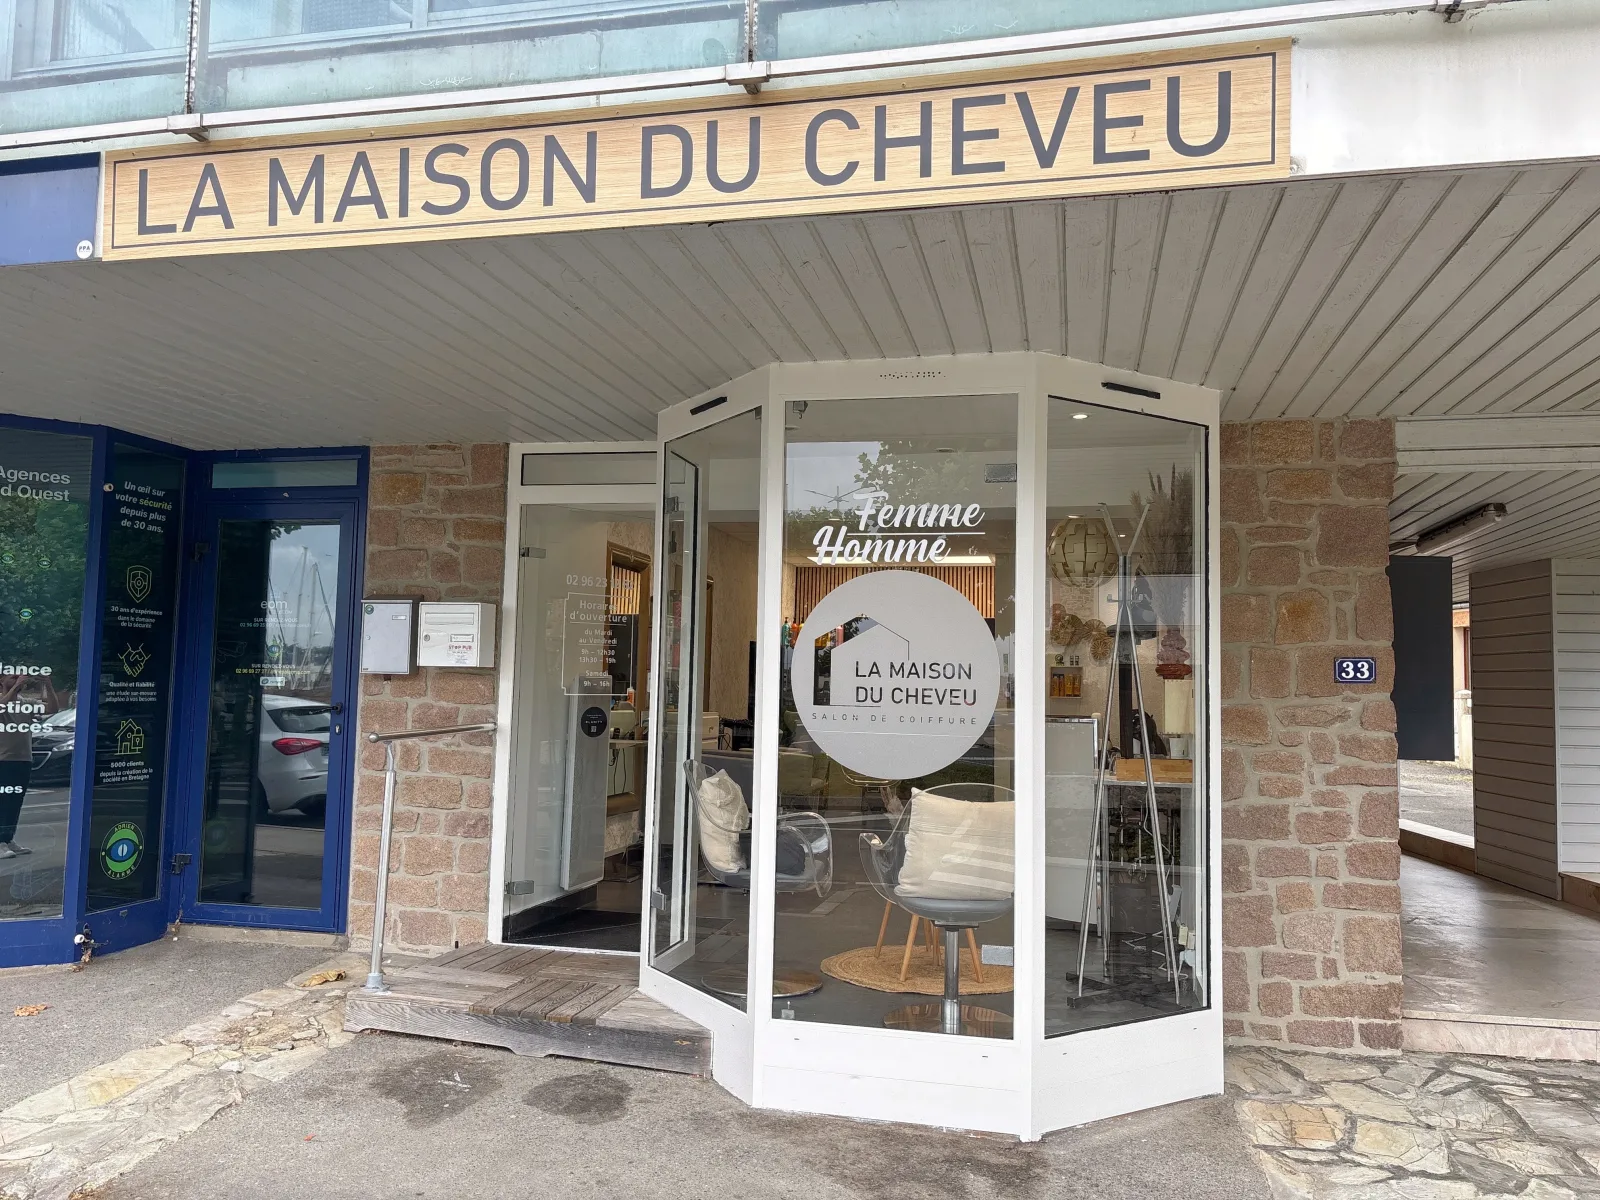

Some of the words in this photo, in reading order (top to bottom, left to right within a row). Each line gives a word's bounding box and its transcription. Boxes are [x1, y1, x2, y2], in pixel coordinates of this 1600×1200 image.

[138, 163, 235, 236] LA
[268, 131, 597, 226] MAISON
[640, 116, 761, 199] DU
[805, 70, 1231, 187] CHEVEU
[0, 466, 70, 485] Agences
[18, 485, 70, 501] Ouest
[124, 482, 136, 490] Un
[138, 484, 151, 494] œil
[152, 488, 166, 497] sur
[116, 493, 138, 504] votre
[140, 497, 172, 510] sécurité
[120, 506, 148, 518] depuis
[148, 512, 166, 523] plus
[852, 490, 985, 531] Femme
[121, 518, 132, 528] de
[134, 520, 146, 530] 30
[147, 524, 164, 532] ans.
[812, 525, 951, 565] Homme
[566, 574, 578, 586] 02
[582, 576, 593, 586] 96
[596, 578, 608, 588] 23
[131, 607, 162, 616] d'expérience
[260, 600, 288, 609] eom
[580, 600, 617, 610] Horaires
[855, 660, 882, 678] LA
[889, 661, 972, 680] MAISON
[1341, 661, 1370, 679] 33
[855, 686, 883, 703] DU
[891, 687, 977, 706] CHEVEU
[812, 712, 859, 721] SALON
[900, 716, 976, 725] COIFFURE
[114, 823, 136, 832] ADRIEN
[108, 864, 136, 878] ALARME
